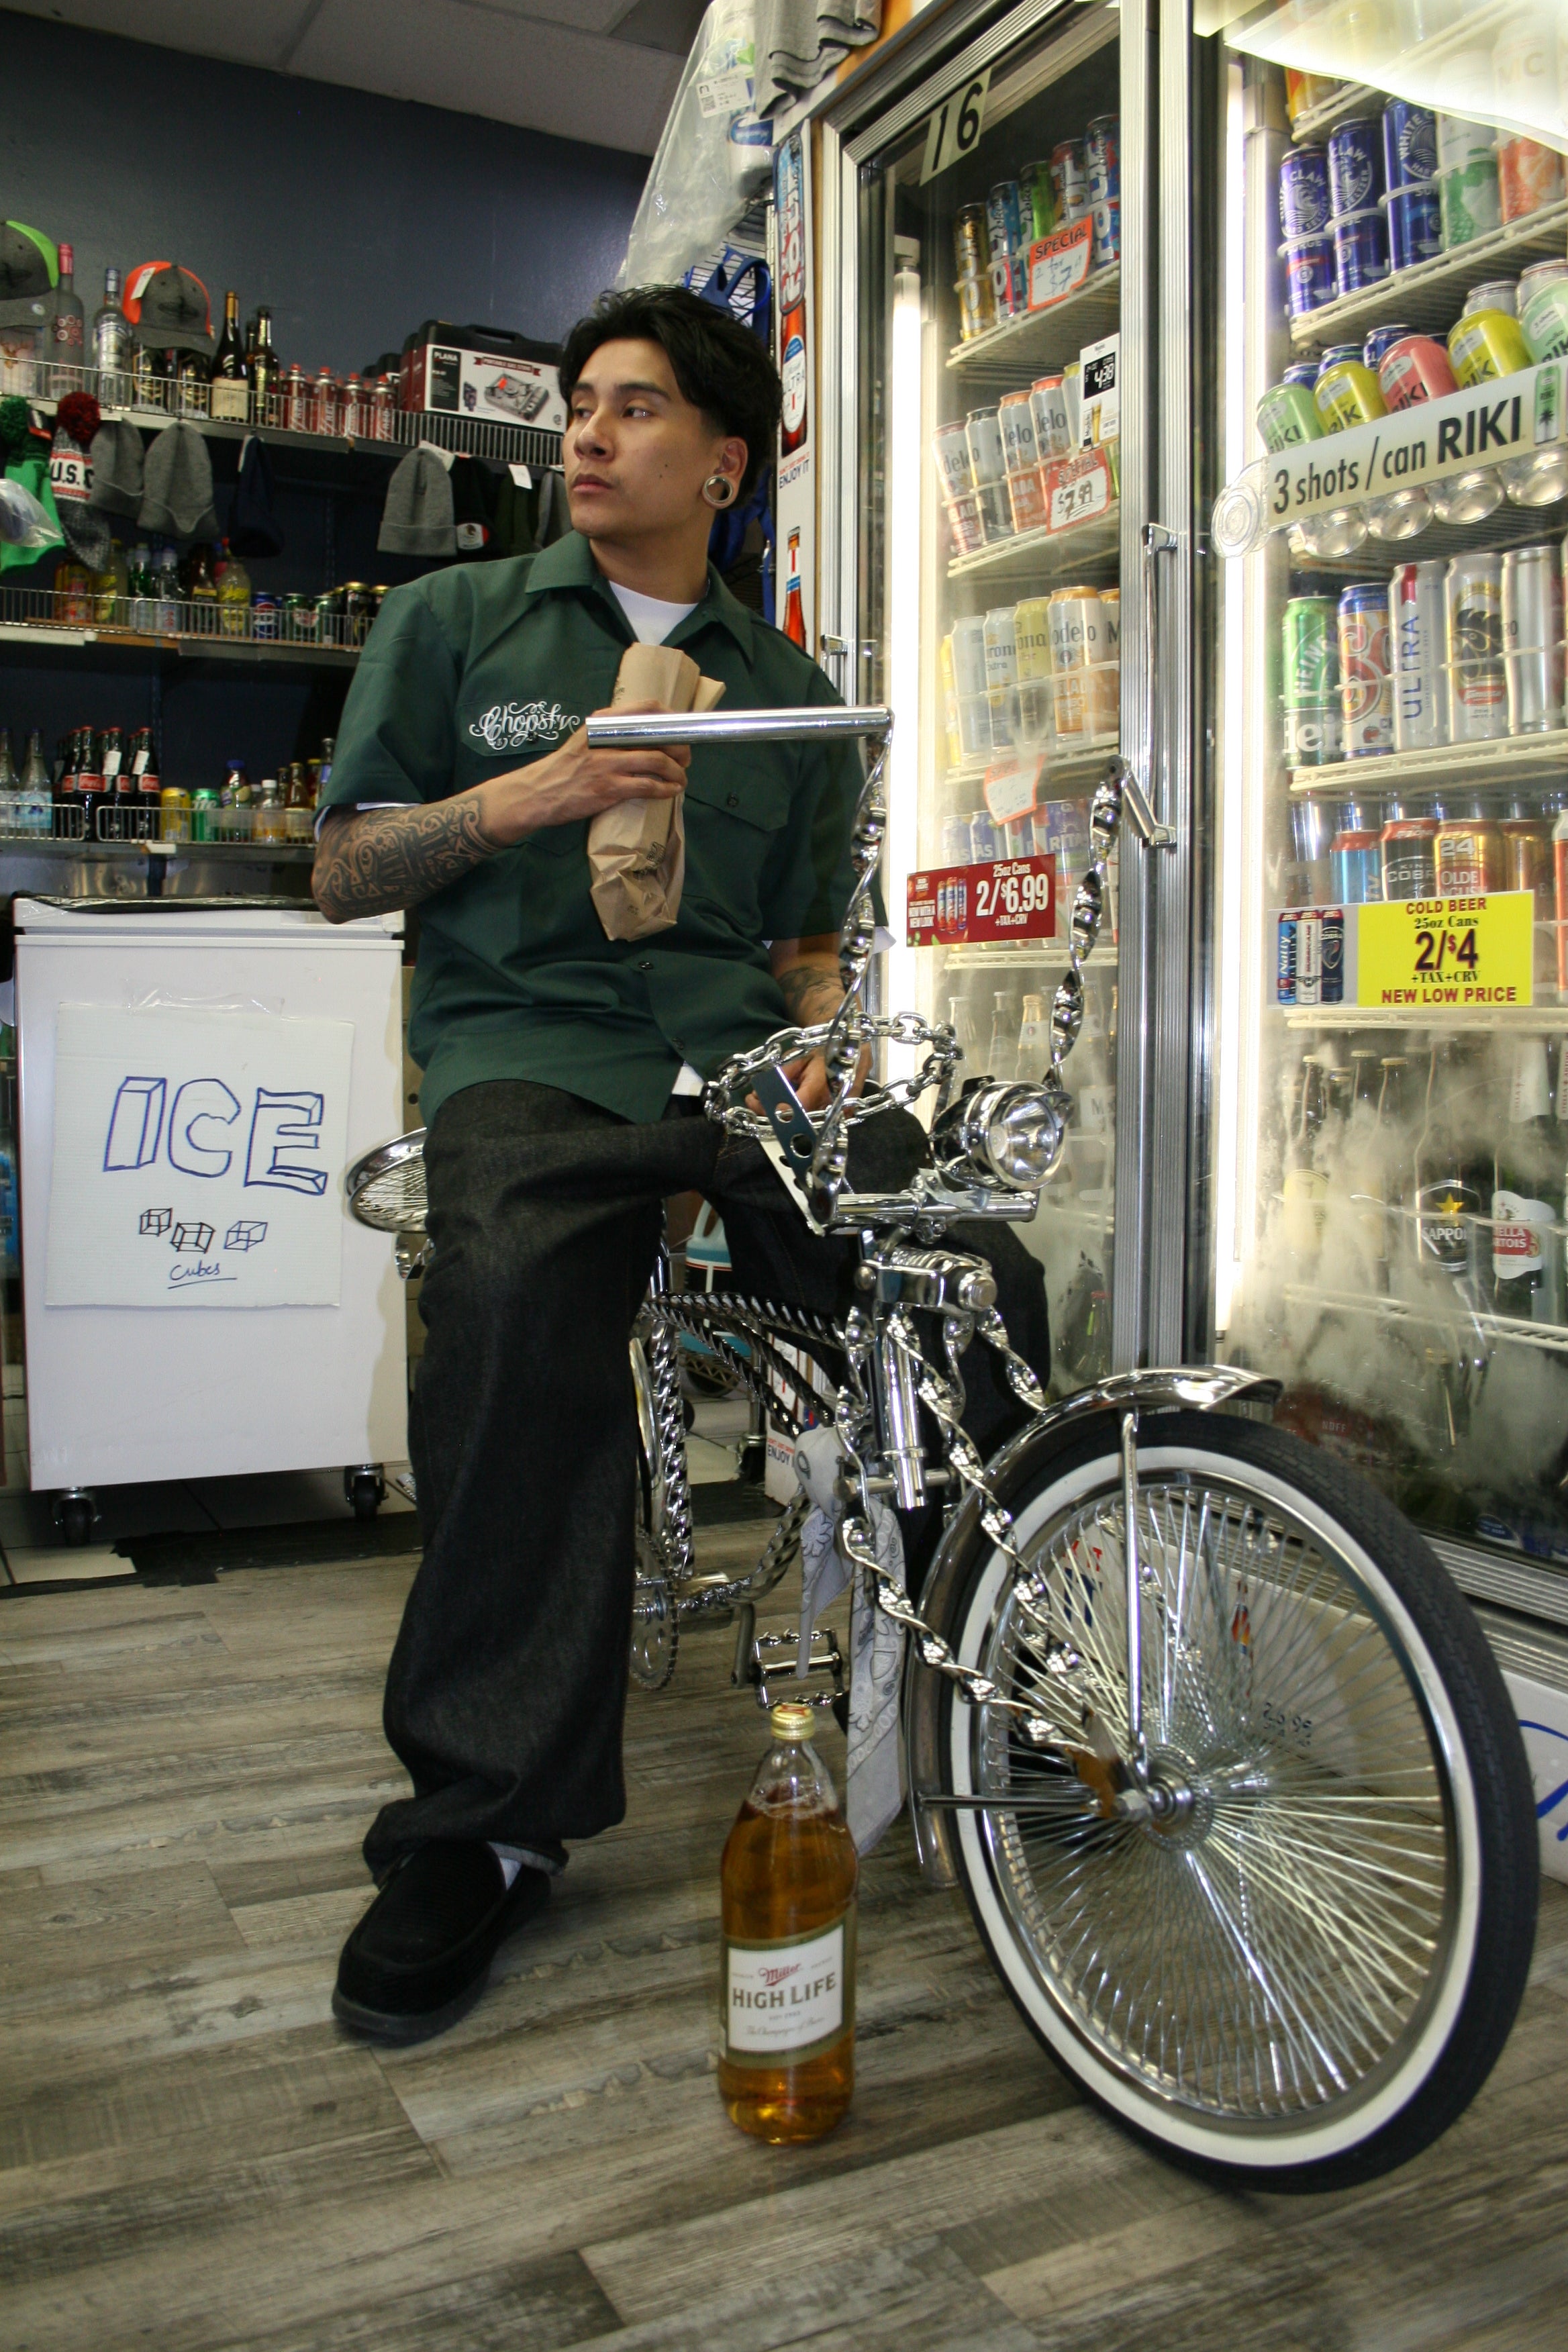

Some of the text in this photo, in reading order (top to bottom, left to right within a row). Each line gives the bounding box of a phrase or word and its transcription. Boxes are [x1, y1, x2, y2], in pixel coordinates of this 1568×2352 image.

[931, 82, 984, 171] 16
[1330, 144, 1367, 161] CLAW
[1289, 170, 1326, 187] CLAW
[1035, 226, 1088, 259] SPECIAL
[1273, 469, 1289, 515] 3
[1296, 460, 1359, 505] shots
[1383, 439, 1425, 479] can
[1438, 396, 1521, 464] RIKI
[779, 466, 801, 489] ENJOY
[1401, 615, 1422, 720] ULTRA
[1440, 838, 1476, 857] 24
[1012, 862, 1031, 875] Cans
[1441, 871, 1478, 886] OLDE
[975, 873, 1048, 916] 2/$6.99
[1406, 897, 1487, 915] COLD BEER
[1414, 915, 1479, 930] 25oz Cans
[1279, 936, 1291, 975] Natty
[1414, 928, 1479, 971] 2/$4
[1382, 986, 1517, 1004] NEW LOW PRICE
[103, 1076, 328, 1195] ICE
[1422, 1227, 1466, 1241] SAPPO
[767, 1444, 791, 1467] ENJOY
[758, 1963, 802, 1987] Miller
[732, 1971, 838, 2009] HIGH LIFE
